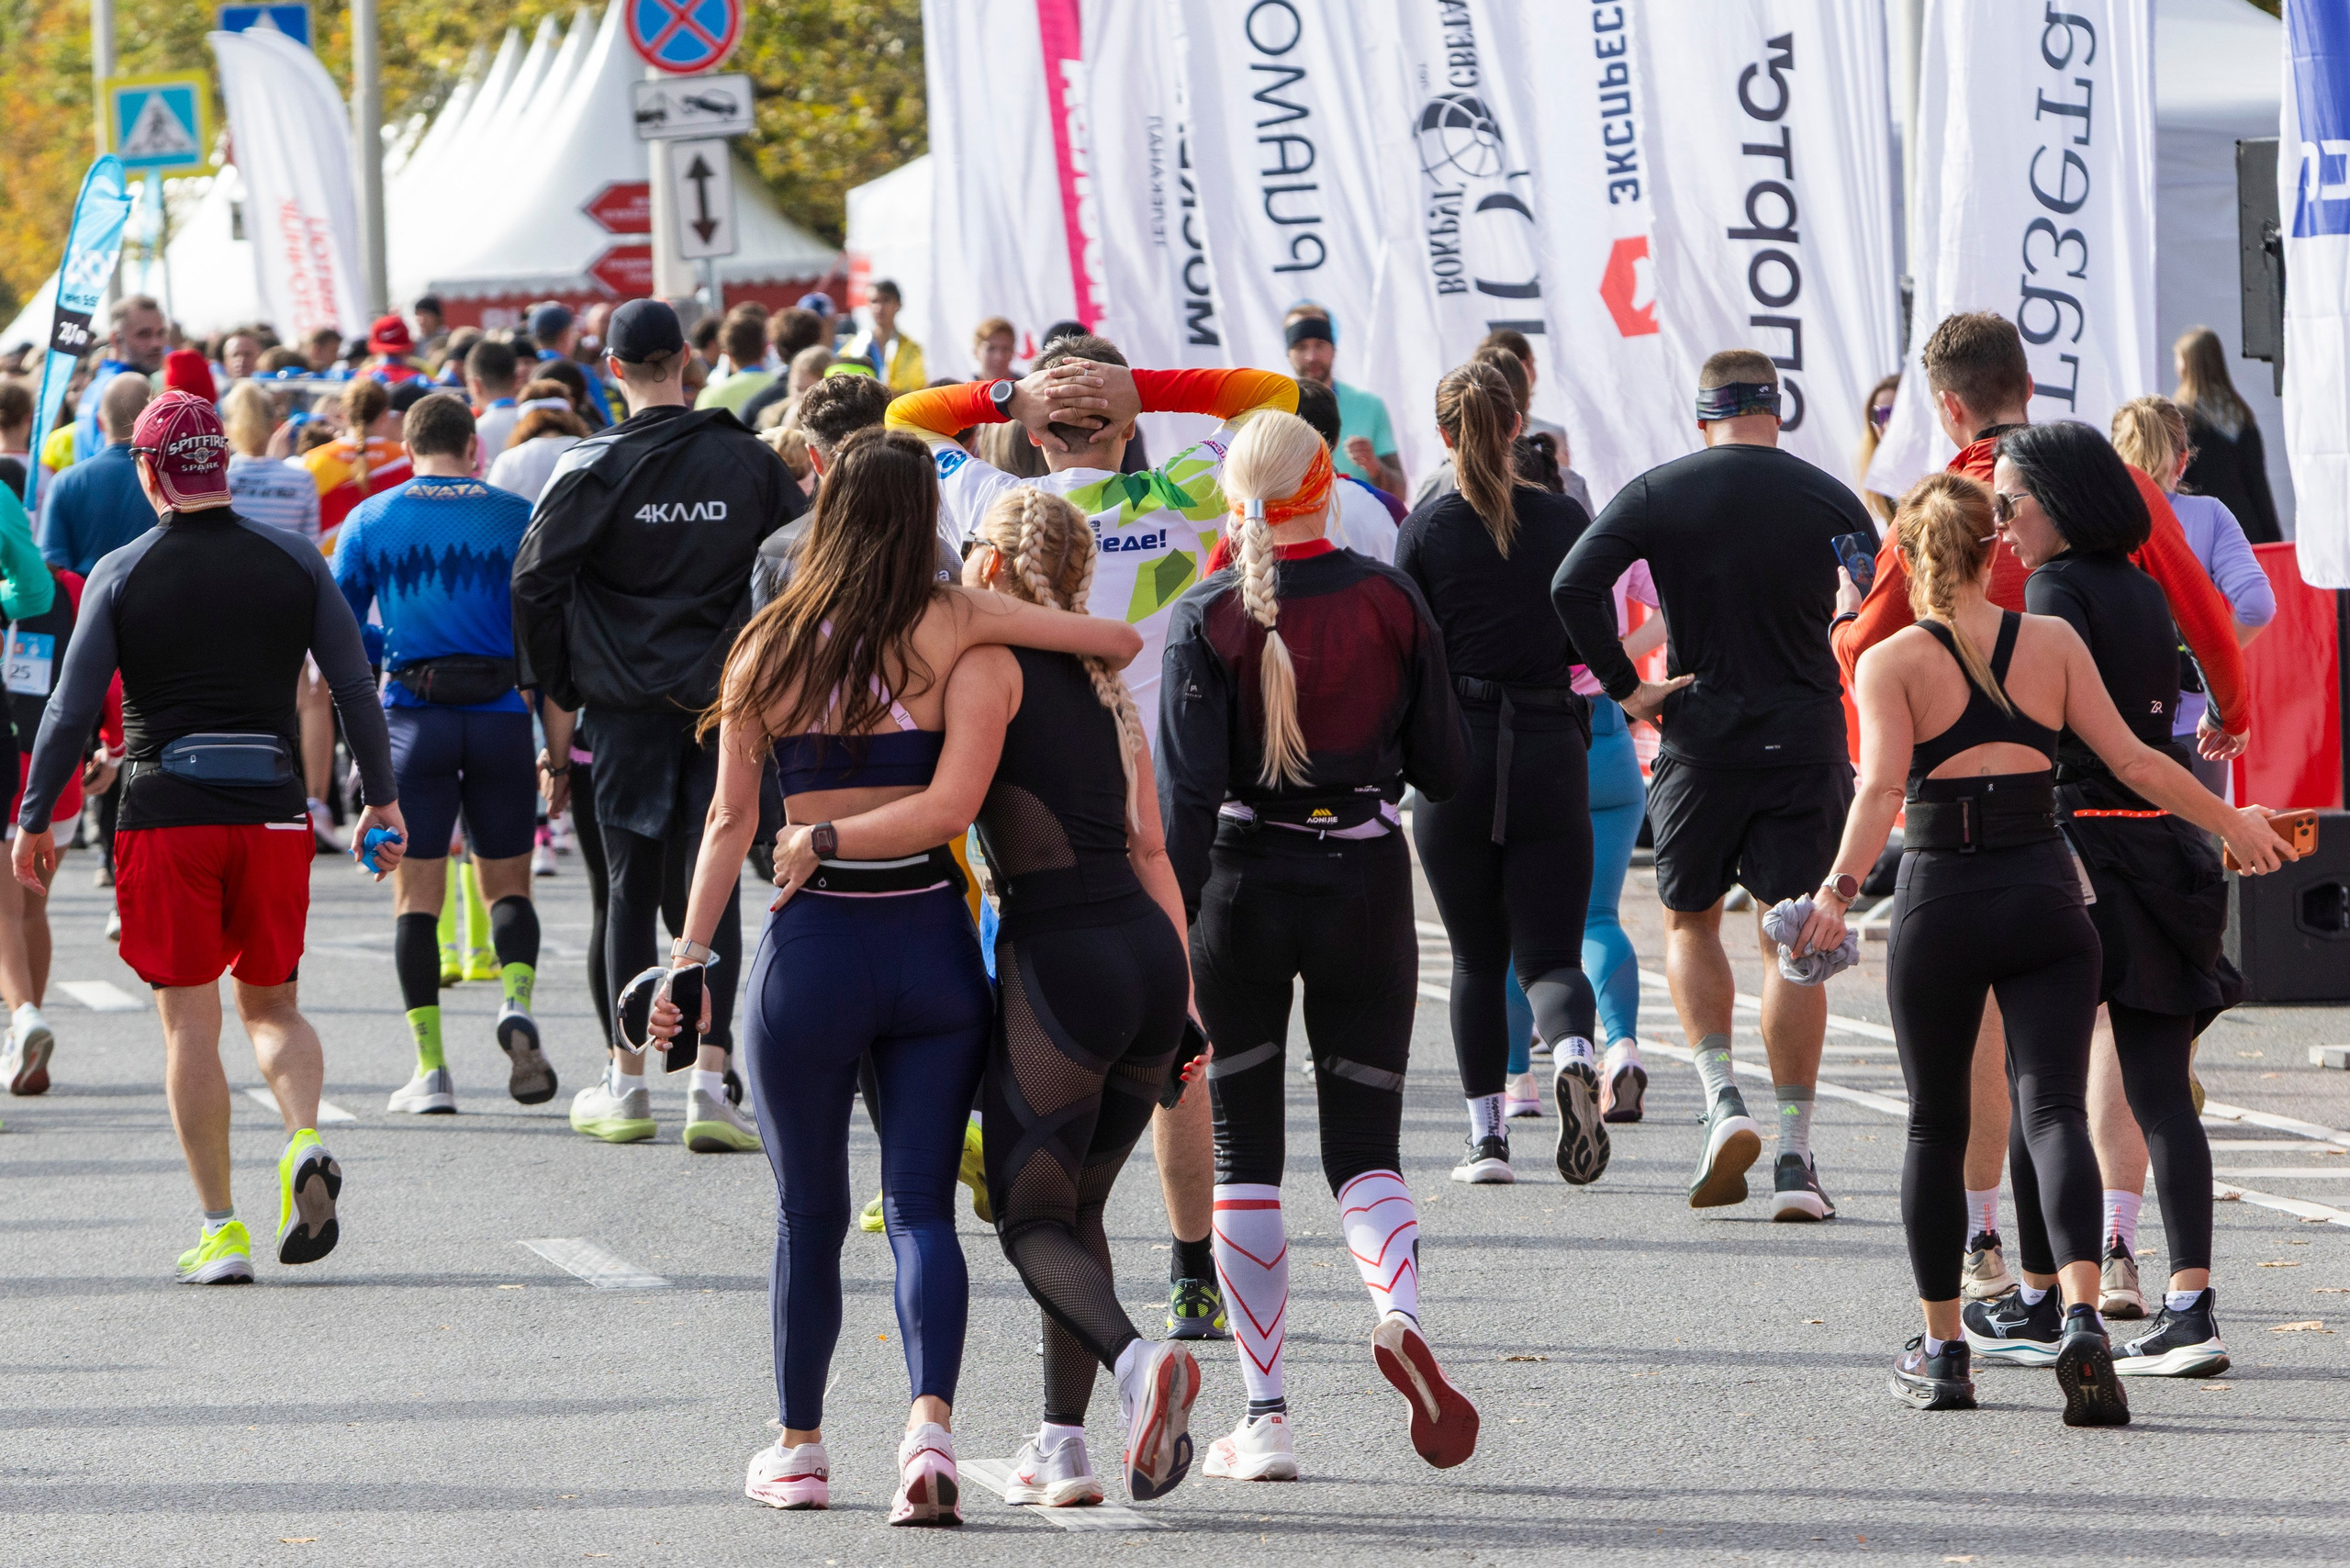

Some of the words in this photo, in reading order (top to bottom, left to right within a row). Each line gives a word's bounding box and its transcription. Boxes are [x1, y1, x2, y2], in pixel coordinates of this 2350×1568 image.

[167, 434, 226, 456] SPITFIRE
[181, 461, 220, 472] SPARK
[1095, 528, 1167, 553] еде!
[1305, 816, 1338, 824] AONIJIE
